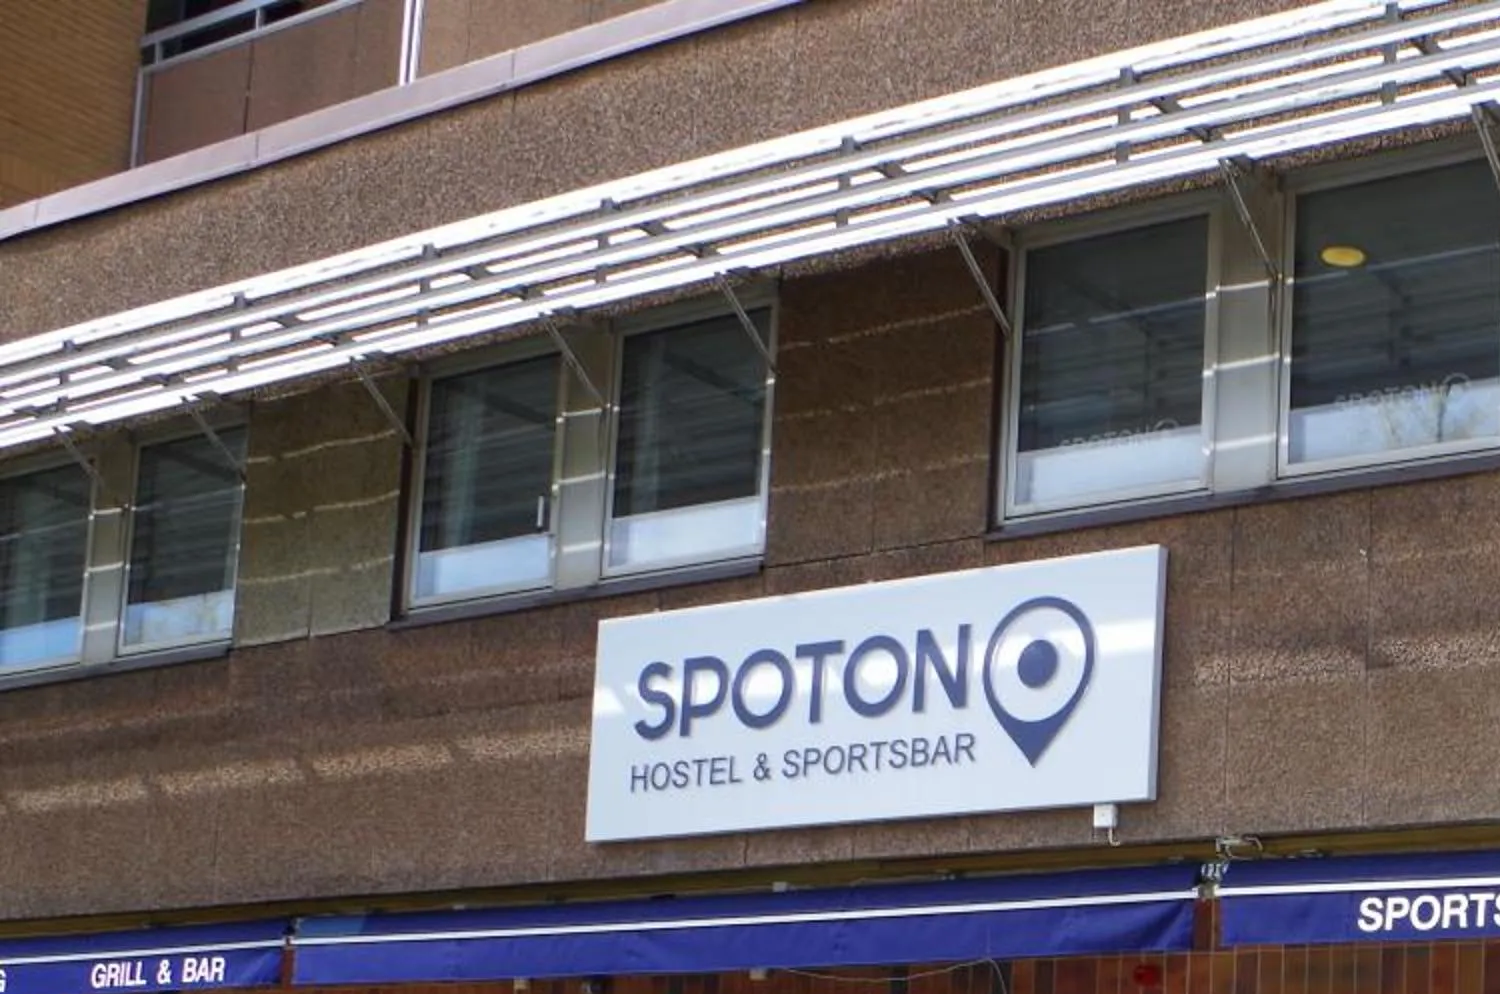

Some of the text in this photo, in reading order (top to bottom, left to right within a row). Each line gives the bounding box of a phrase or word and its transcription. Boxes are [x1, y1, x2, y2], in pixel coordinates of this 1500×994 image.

[634, 623, 972, 740] SPOTON
[630, 733, 976, 793] HOSTEL & SPORTSBAR
[91, 957, 226, 989] GRILL & BAR
